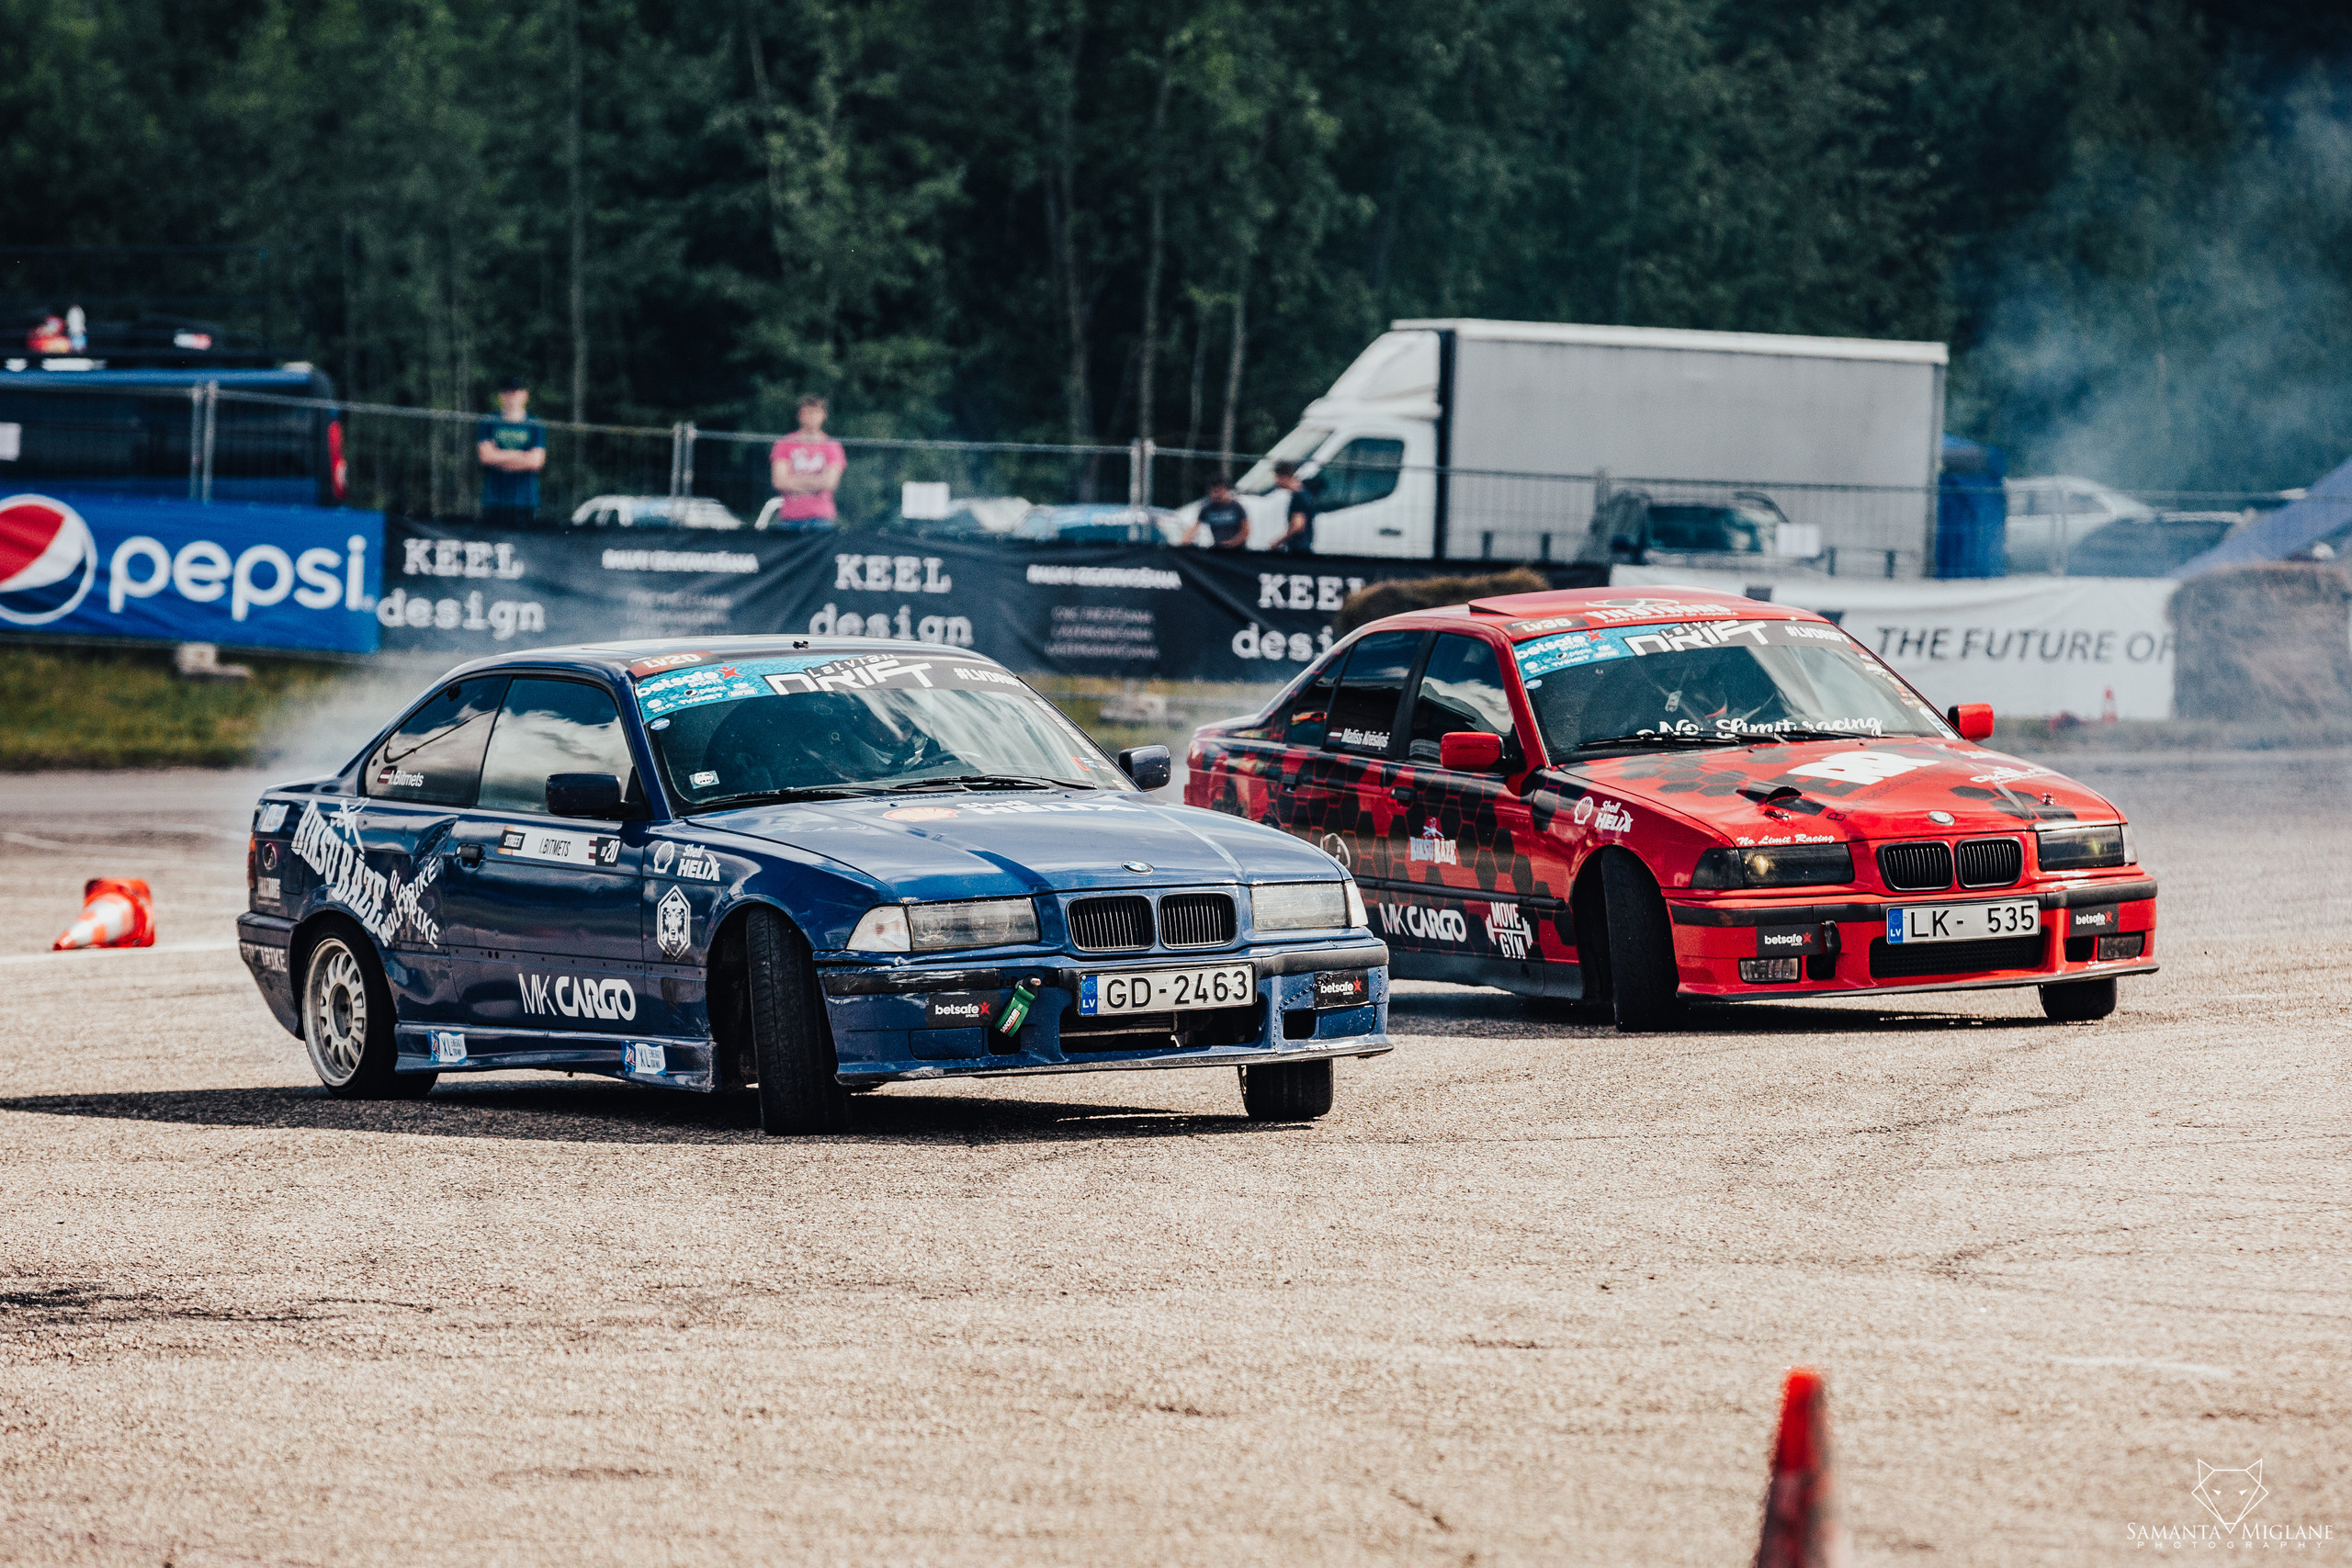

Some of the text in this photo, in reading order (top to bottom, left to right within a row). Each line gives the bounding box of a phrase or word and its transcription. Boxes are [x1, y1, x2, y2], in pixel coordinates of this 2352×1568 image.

[404, 537, 525, 580] KEEL
[109, 536, 367, 621] pepsi
[834, 553, 952, 593] KEEL
[376, 589, 545, 640] design
[809, 603, 973, 646] design
[1877, 626, 1953, 661] THE
[1958, 627, 2118, 664] FUTURE
[643, 653, 702, 669] LV20
[1594, 809, 1634, 832] HELIX
[682, 844, 707, 858] Shell
[1736, 833, 1835, 845] No Limit Racing
[676, 853, 721, 882] HELIX
[1379, 902, 1467, 942] MK CARGO
[1490, 901, 1521, 930] MOVE
[1764, 933, 1803, 944] betsafe
[1890, 928, 1902, 937] LV
[518, 973, 637, 1021] MK CARGO
[1320, 980, 1354, 994] betsafe
[934, 1003, 979, 1015] betsafe
[1082, 998, 1096, 1009] LV
[638, 1047, 651, 1068] XL
